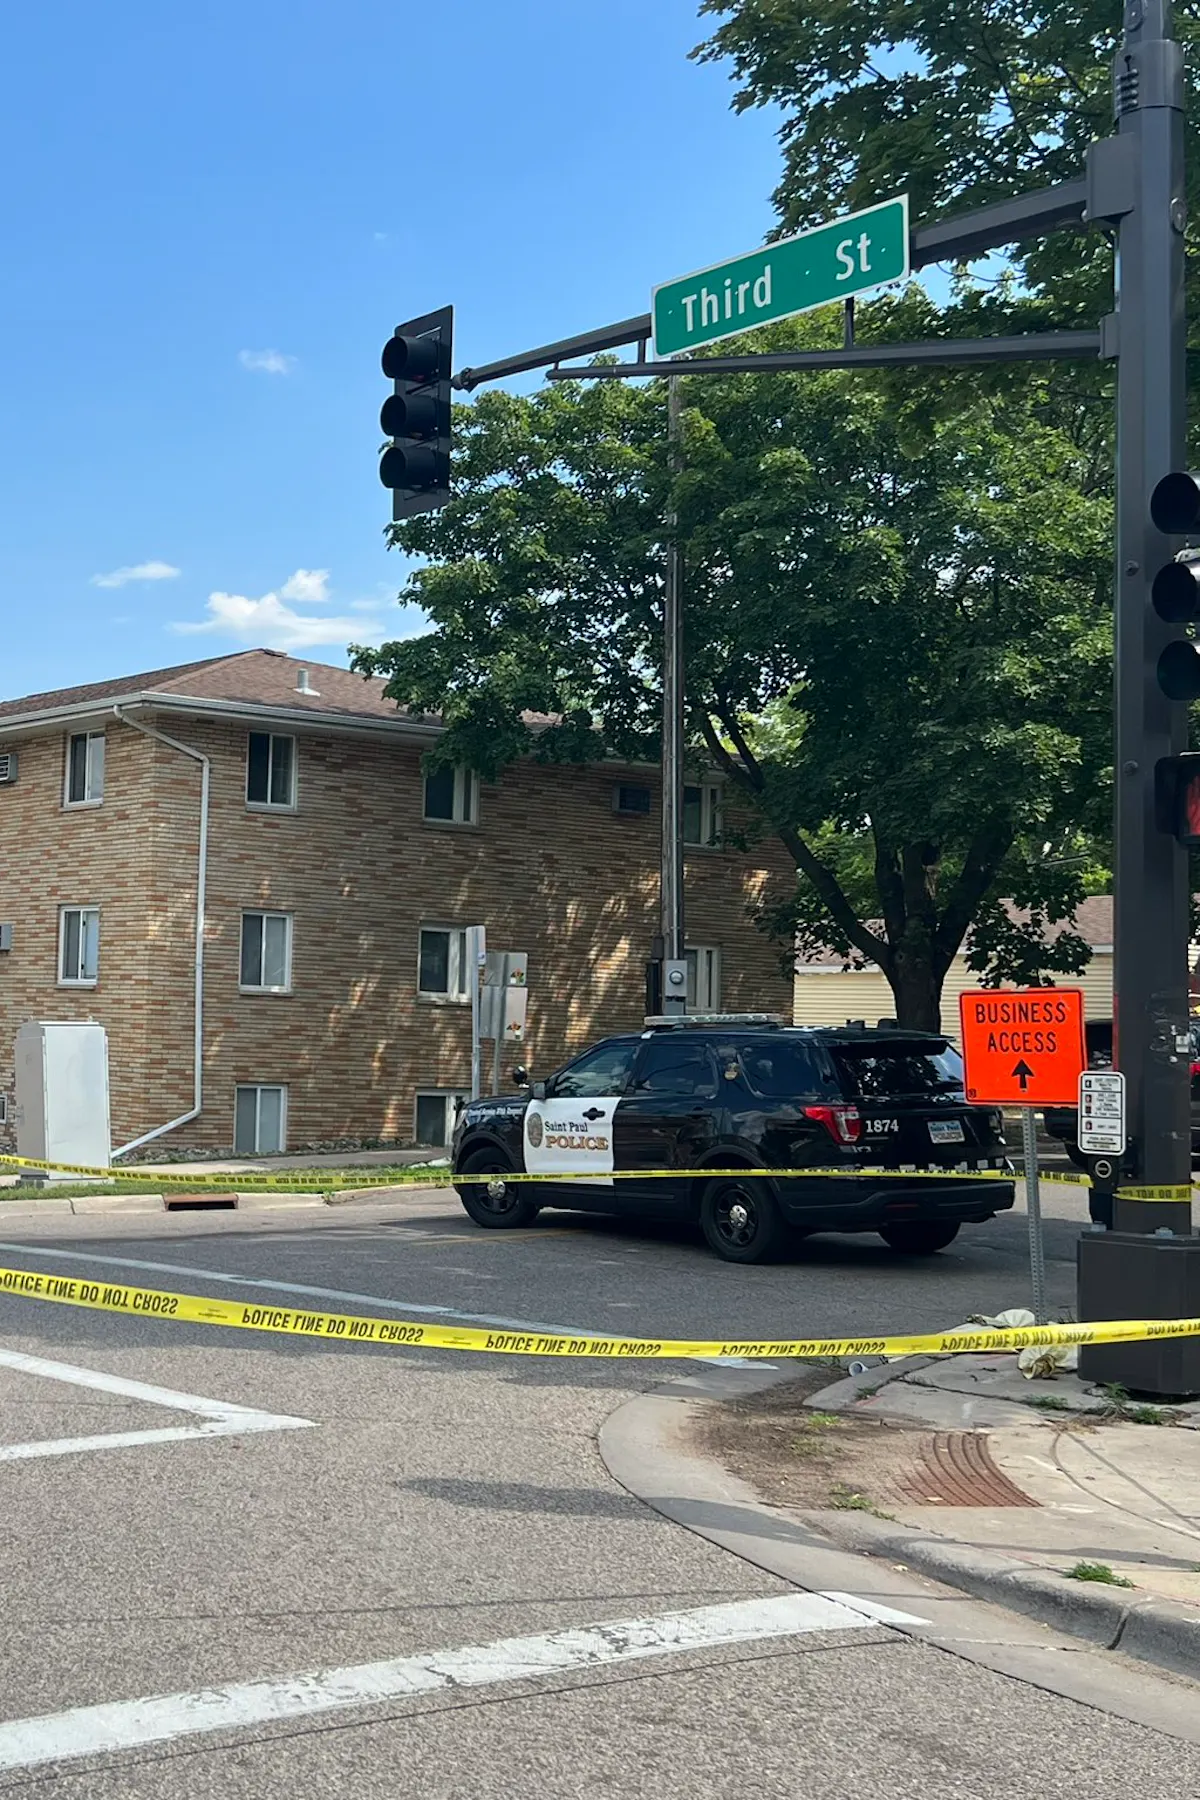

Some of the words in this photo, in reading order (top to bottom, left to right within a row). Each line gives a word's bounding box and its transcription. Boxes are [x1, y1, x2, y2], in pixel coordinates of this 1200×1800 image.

[681, 264, 772, 333] Third
[835, 232, 872, 281] St
[975, 1002, 1066, 1024] BUSINESS
[987, 1032, 1057, 1053] ACCESS
[544, 1121, 567, 1132] Saint
[569, 1121, 588, 1132] Paul
[865, 1119, 899, 1133] 1874
[545, 1135, 609, 1150] POLICE
